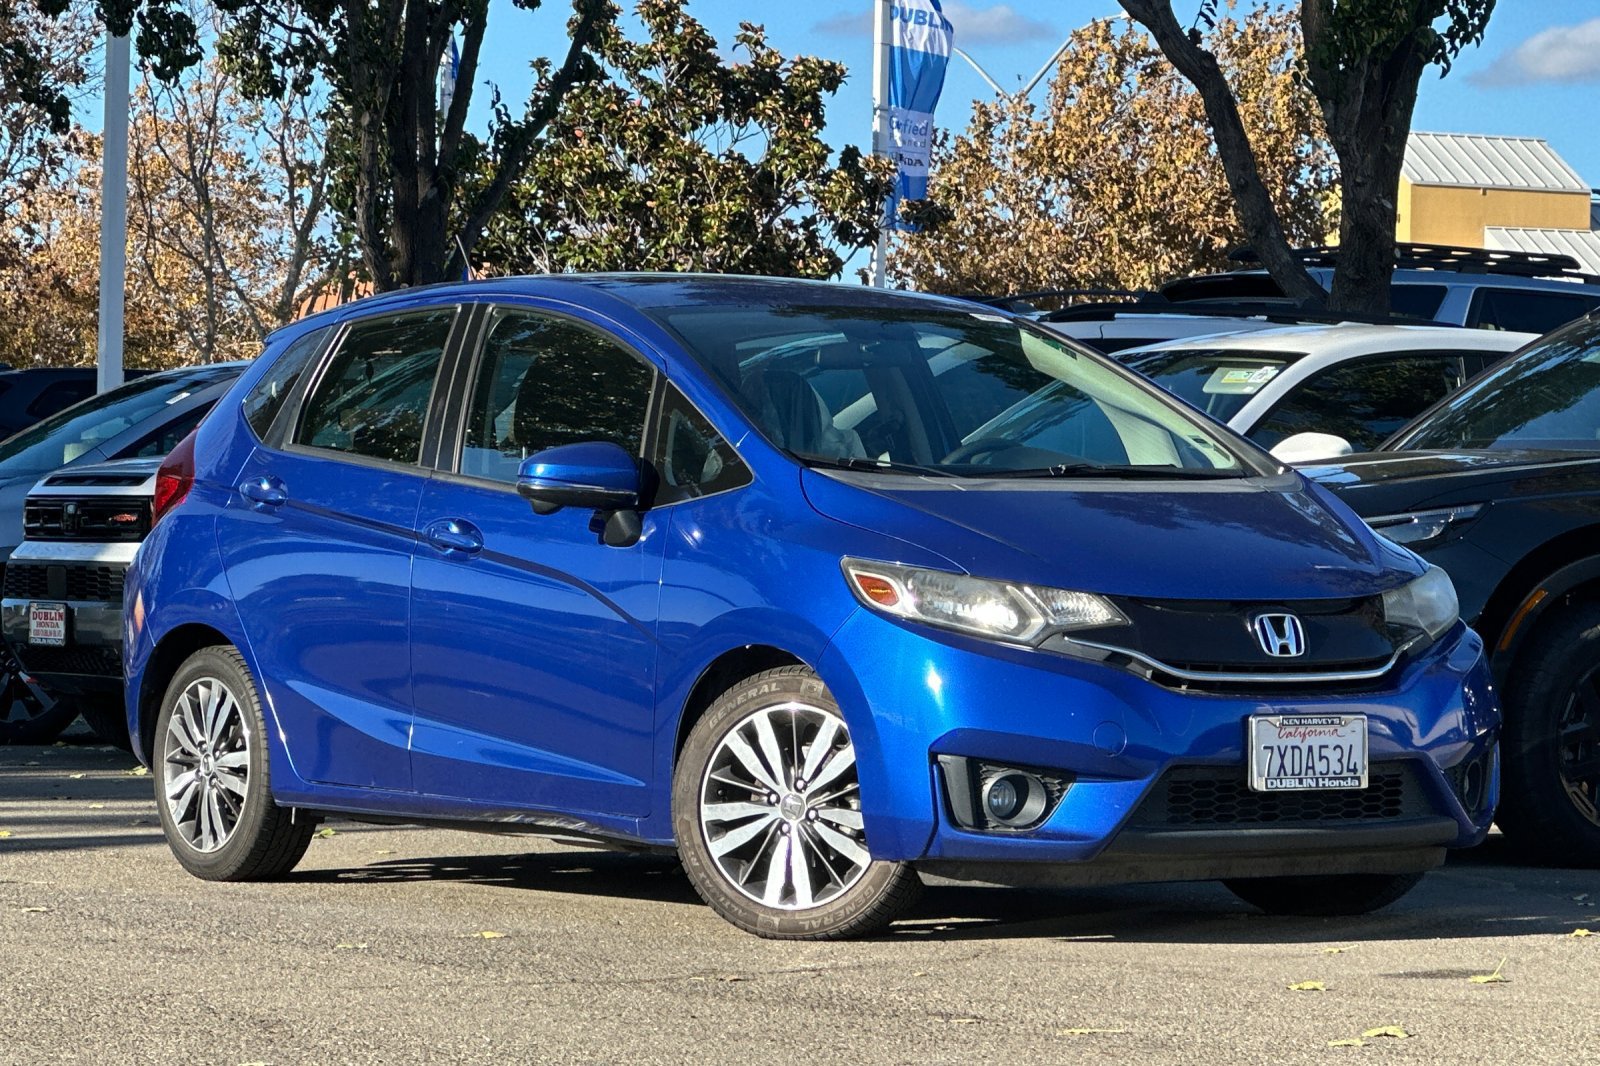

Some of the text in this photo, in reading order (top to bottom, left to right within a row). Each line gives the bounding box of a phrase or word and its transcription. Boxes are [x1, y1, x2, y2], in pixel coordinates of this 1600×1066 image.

[32, 611, 64, 621] DUBLIN
[709, 682, 780, 729] GENERAL
[1283, 718, 1341, 726] KEN HARVEY'S
[1278, 726, 1345, 743] California
[1262, 744, 1359, 777] 7XDA534
[1267, 777, 1359, 788] DUBLIN Honda
[800, 885, 875, 931] GENERAL
